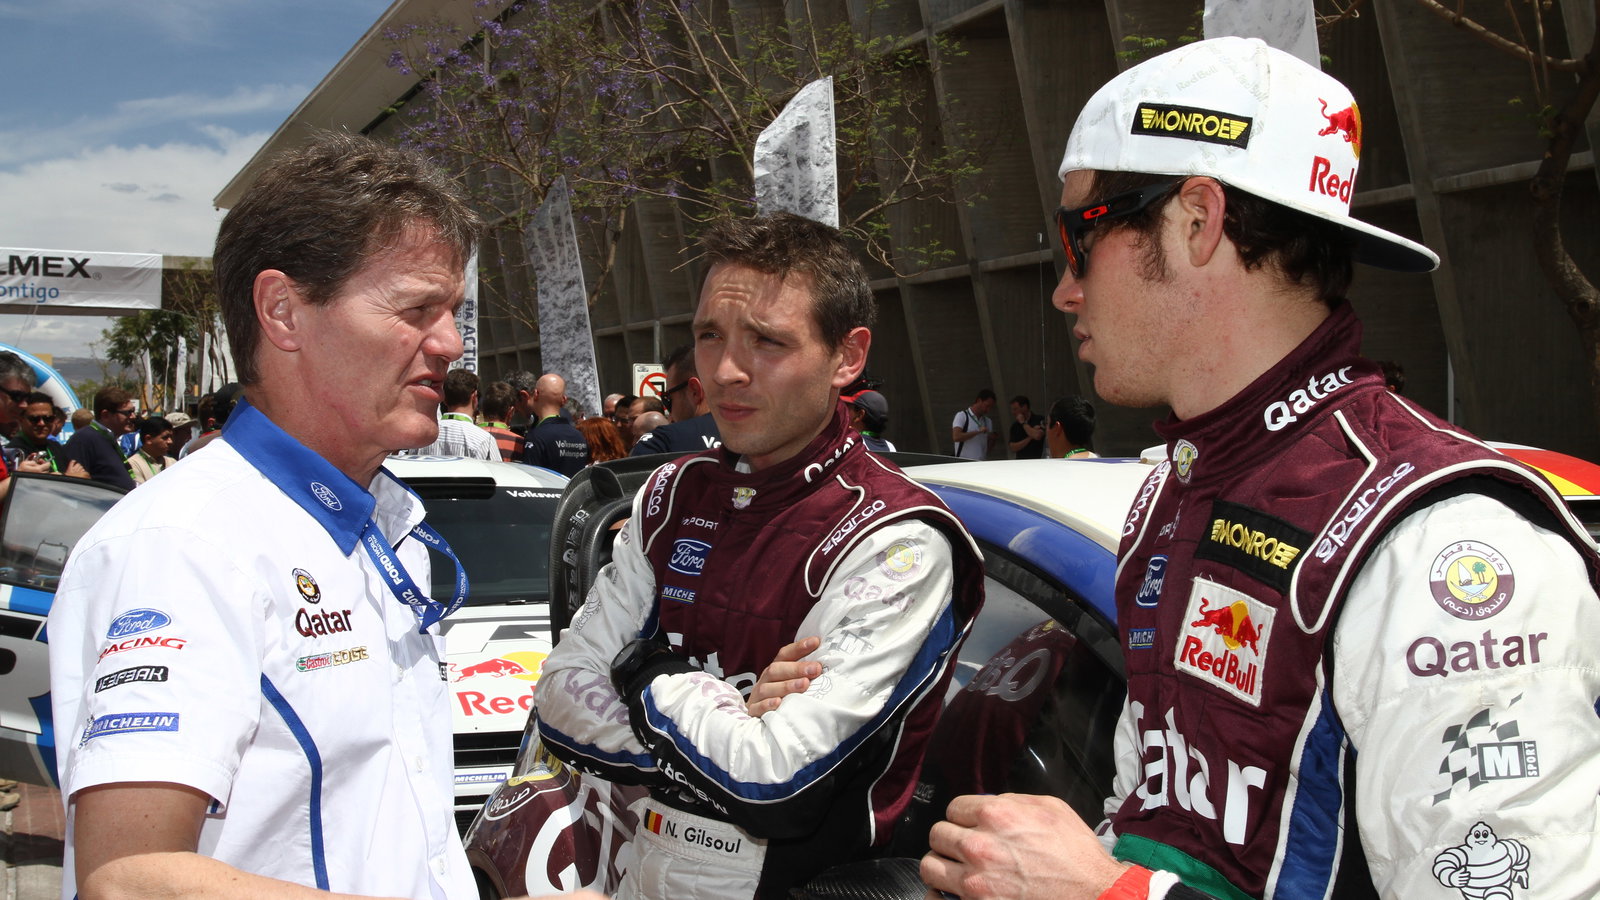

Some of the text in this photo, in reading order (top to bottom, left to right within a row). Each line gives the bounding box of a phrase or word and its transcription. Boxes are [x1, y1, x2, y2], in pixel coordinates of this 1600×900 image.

[1149, 110, 1231, 139] MONROE
[0, 255, 91, 279] MEX
[1264, 365, 1353, 432] Qatar
[314, 485, 336, 509] Ford
[1315, 461, 1416, 564] sparco
[821, 500, 887, 556] sparco
[1216, 518, 1291, 570] MONROE
[379, 553, 403, 586] FORD
[113, 613, 157, 636] Ford
[295, 607, 352, 638] Qatar
[332, 646, 369, 667] EDGE
[1406, 629, 1548, 678] Qatar
[93, 715, 176, 732] MICHELIN
[1483, 742, 1539, 778] M SPORT
[454, 774, 506, 784] MICHELIN
[664, 819, 741, 854] N. Gilsoul
